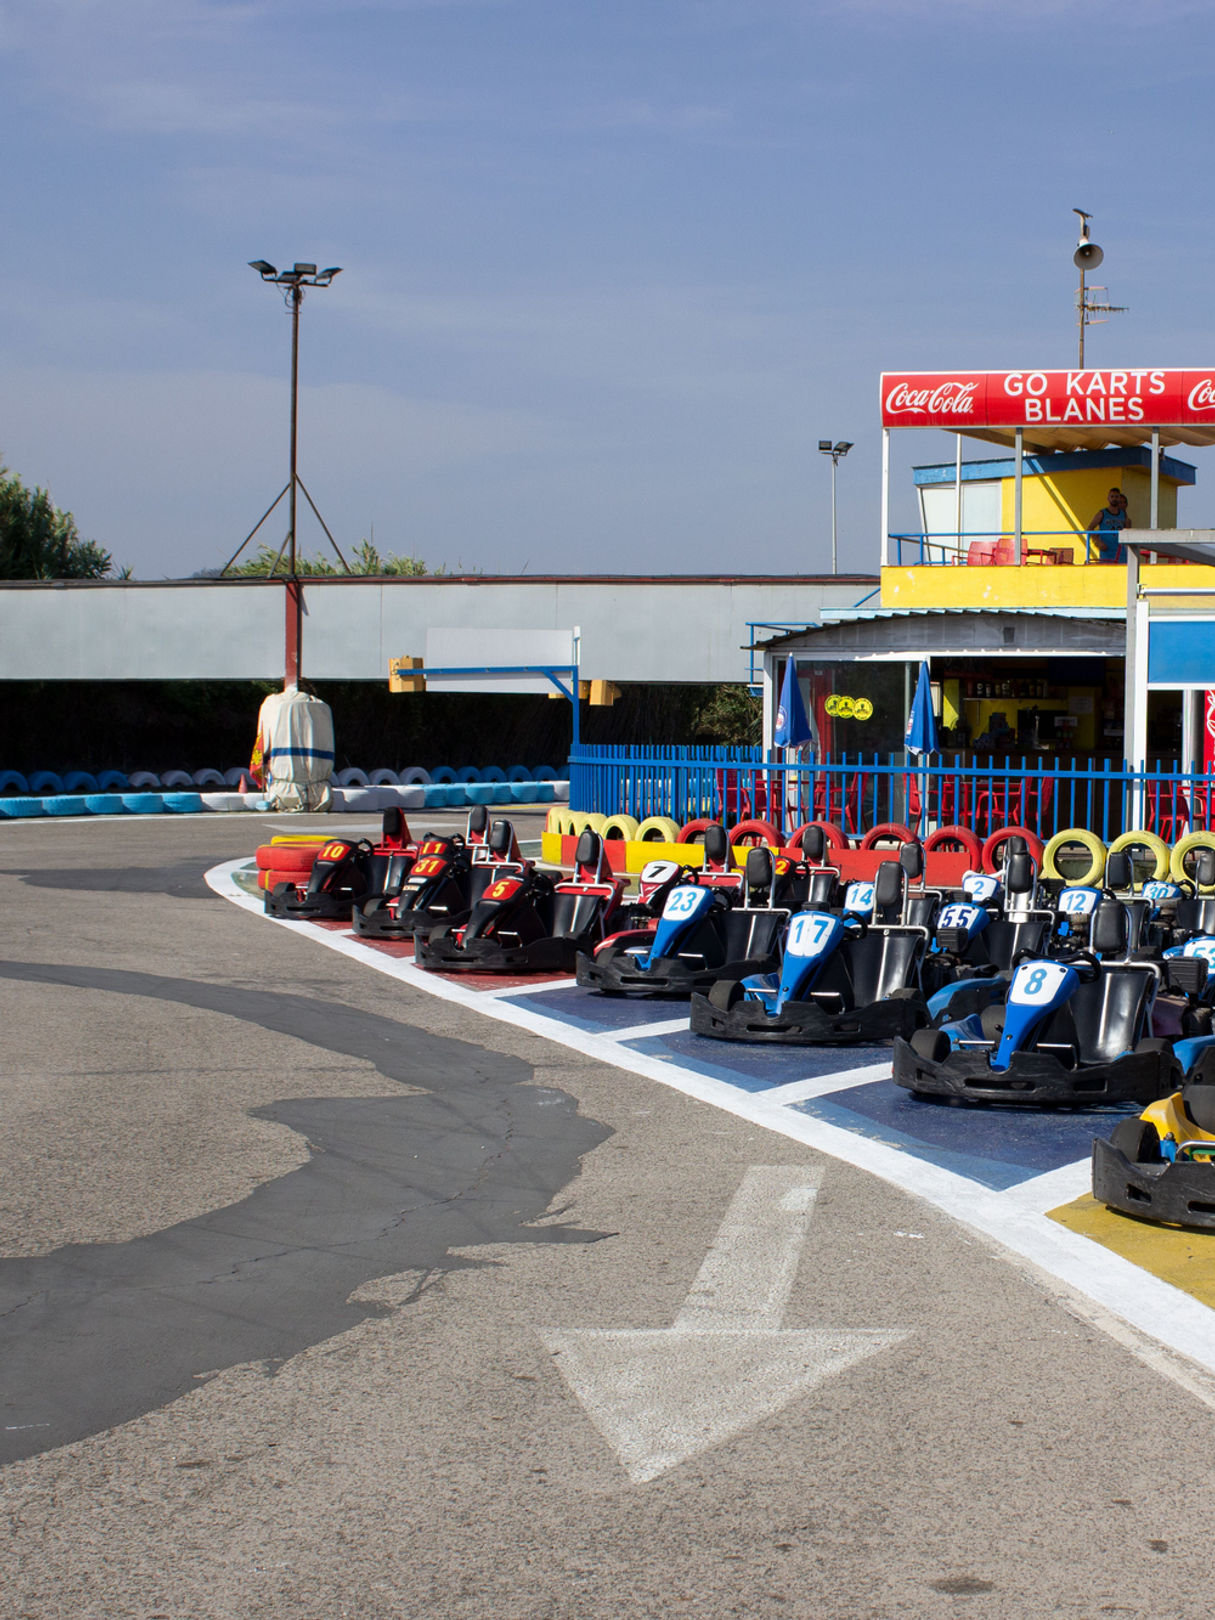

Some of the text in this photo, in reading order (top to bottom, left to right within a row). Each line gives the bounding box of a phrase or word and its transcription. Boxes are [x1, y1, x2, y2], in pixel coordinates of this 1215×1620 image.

[1003, 371, 1165, 396] GO KARTS
[885, 382, 979, 414] Coca-Cola
[1025, 397, 1144, 422] BLANES
[322, 845, 345, 858] 10
[422, 841, 442, 854] 11
[415, 859, 439, 873] 31
[647, 865, 668, 878] 7
[492, 881, 510, 897] 5
[851, 888, 873, 905] 14
[973, 881, 985, 895] 2
[668, 891, 697, 912] 23
[1066, 893, 1087, 911] 12
[942, 909, 971, 928] 55
[796, 919, 829, 944] 17
[1024, 968, 1048, 995] 8
